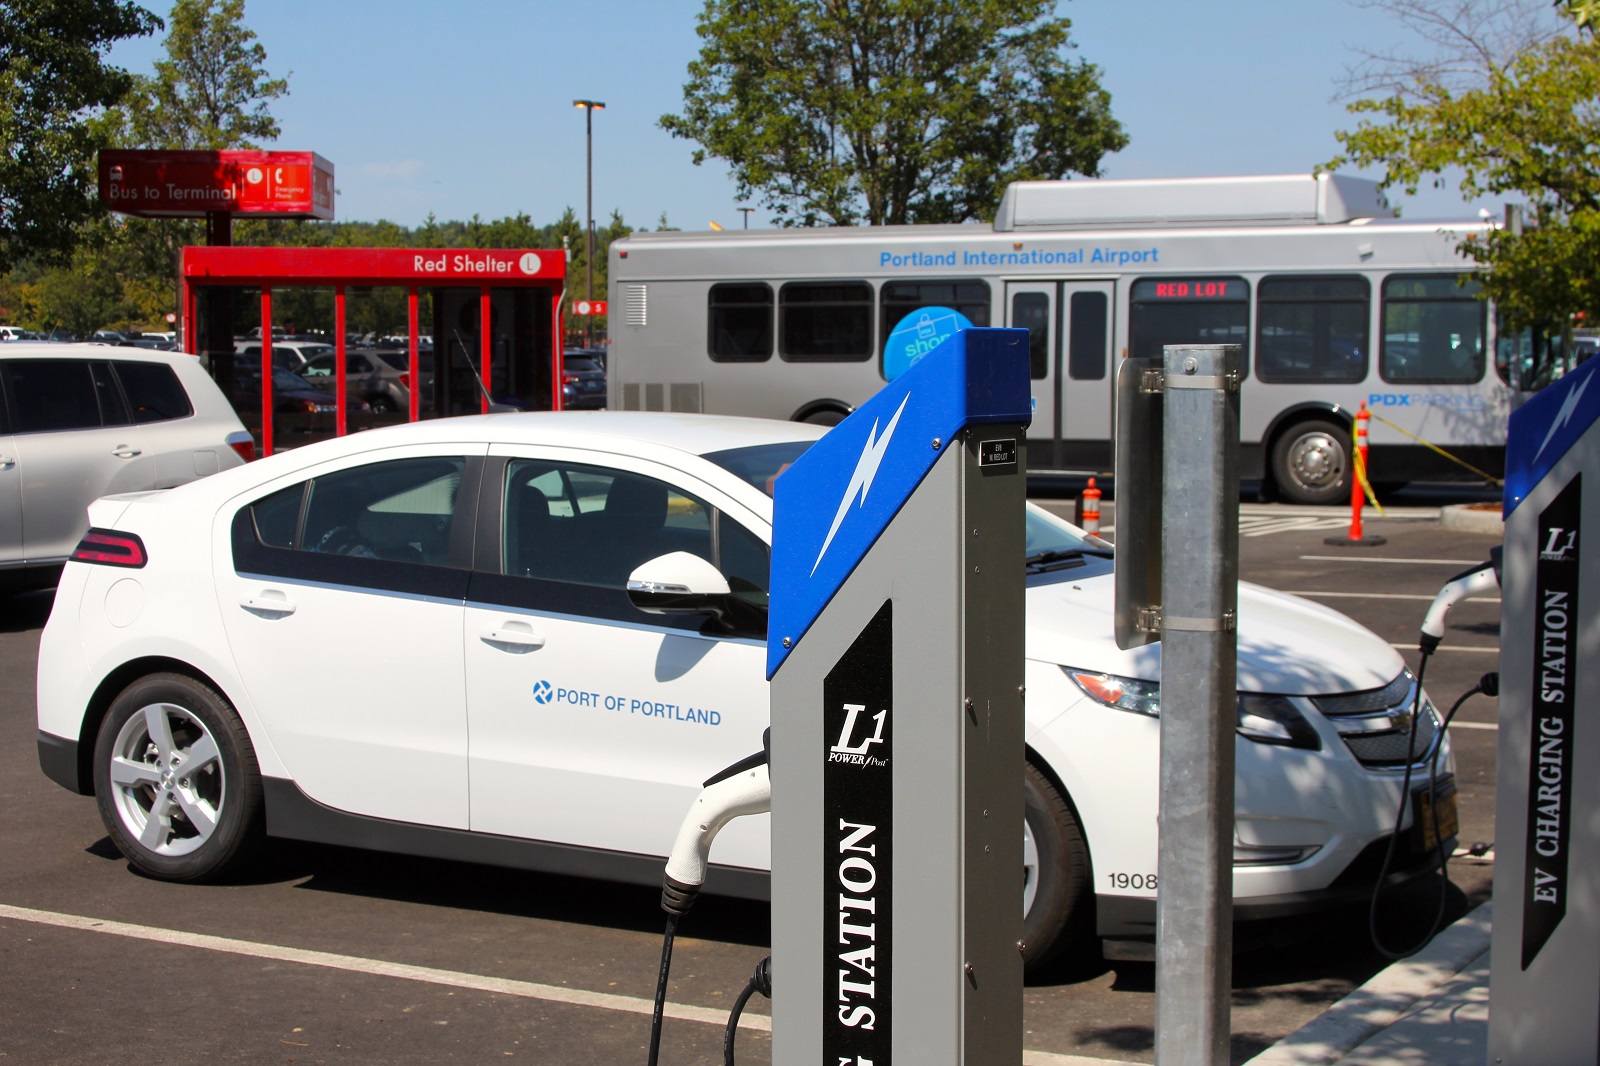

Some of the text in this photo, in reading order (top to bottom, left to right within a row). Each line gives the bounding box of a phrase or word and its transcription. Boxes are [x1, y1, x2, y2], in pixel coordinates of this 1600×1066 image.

[110, 183, 236, 199] Bus to Terminal
[414, 255, 514, 272] Red Shelter
[880, 247, 1159, 267] Portland International Airport
[1156, 282, 1227, 297] RED LOT
[557, 688, 721, 726] PORT OF PORTLAND
[1534, 589, 1568, 904] EV CHARGING STATION
[828, 752, 865, 765] POWER
[1108, 872, 1158, 890] 1908
[838, 818, 877, 1031] STATION
